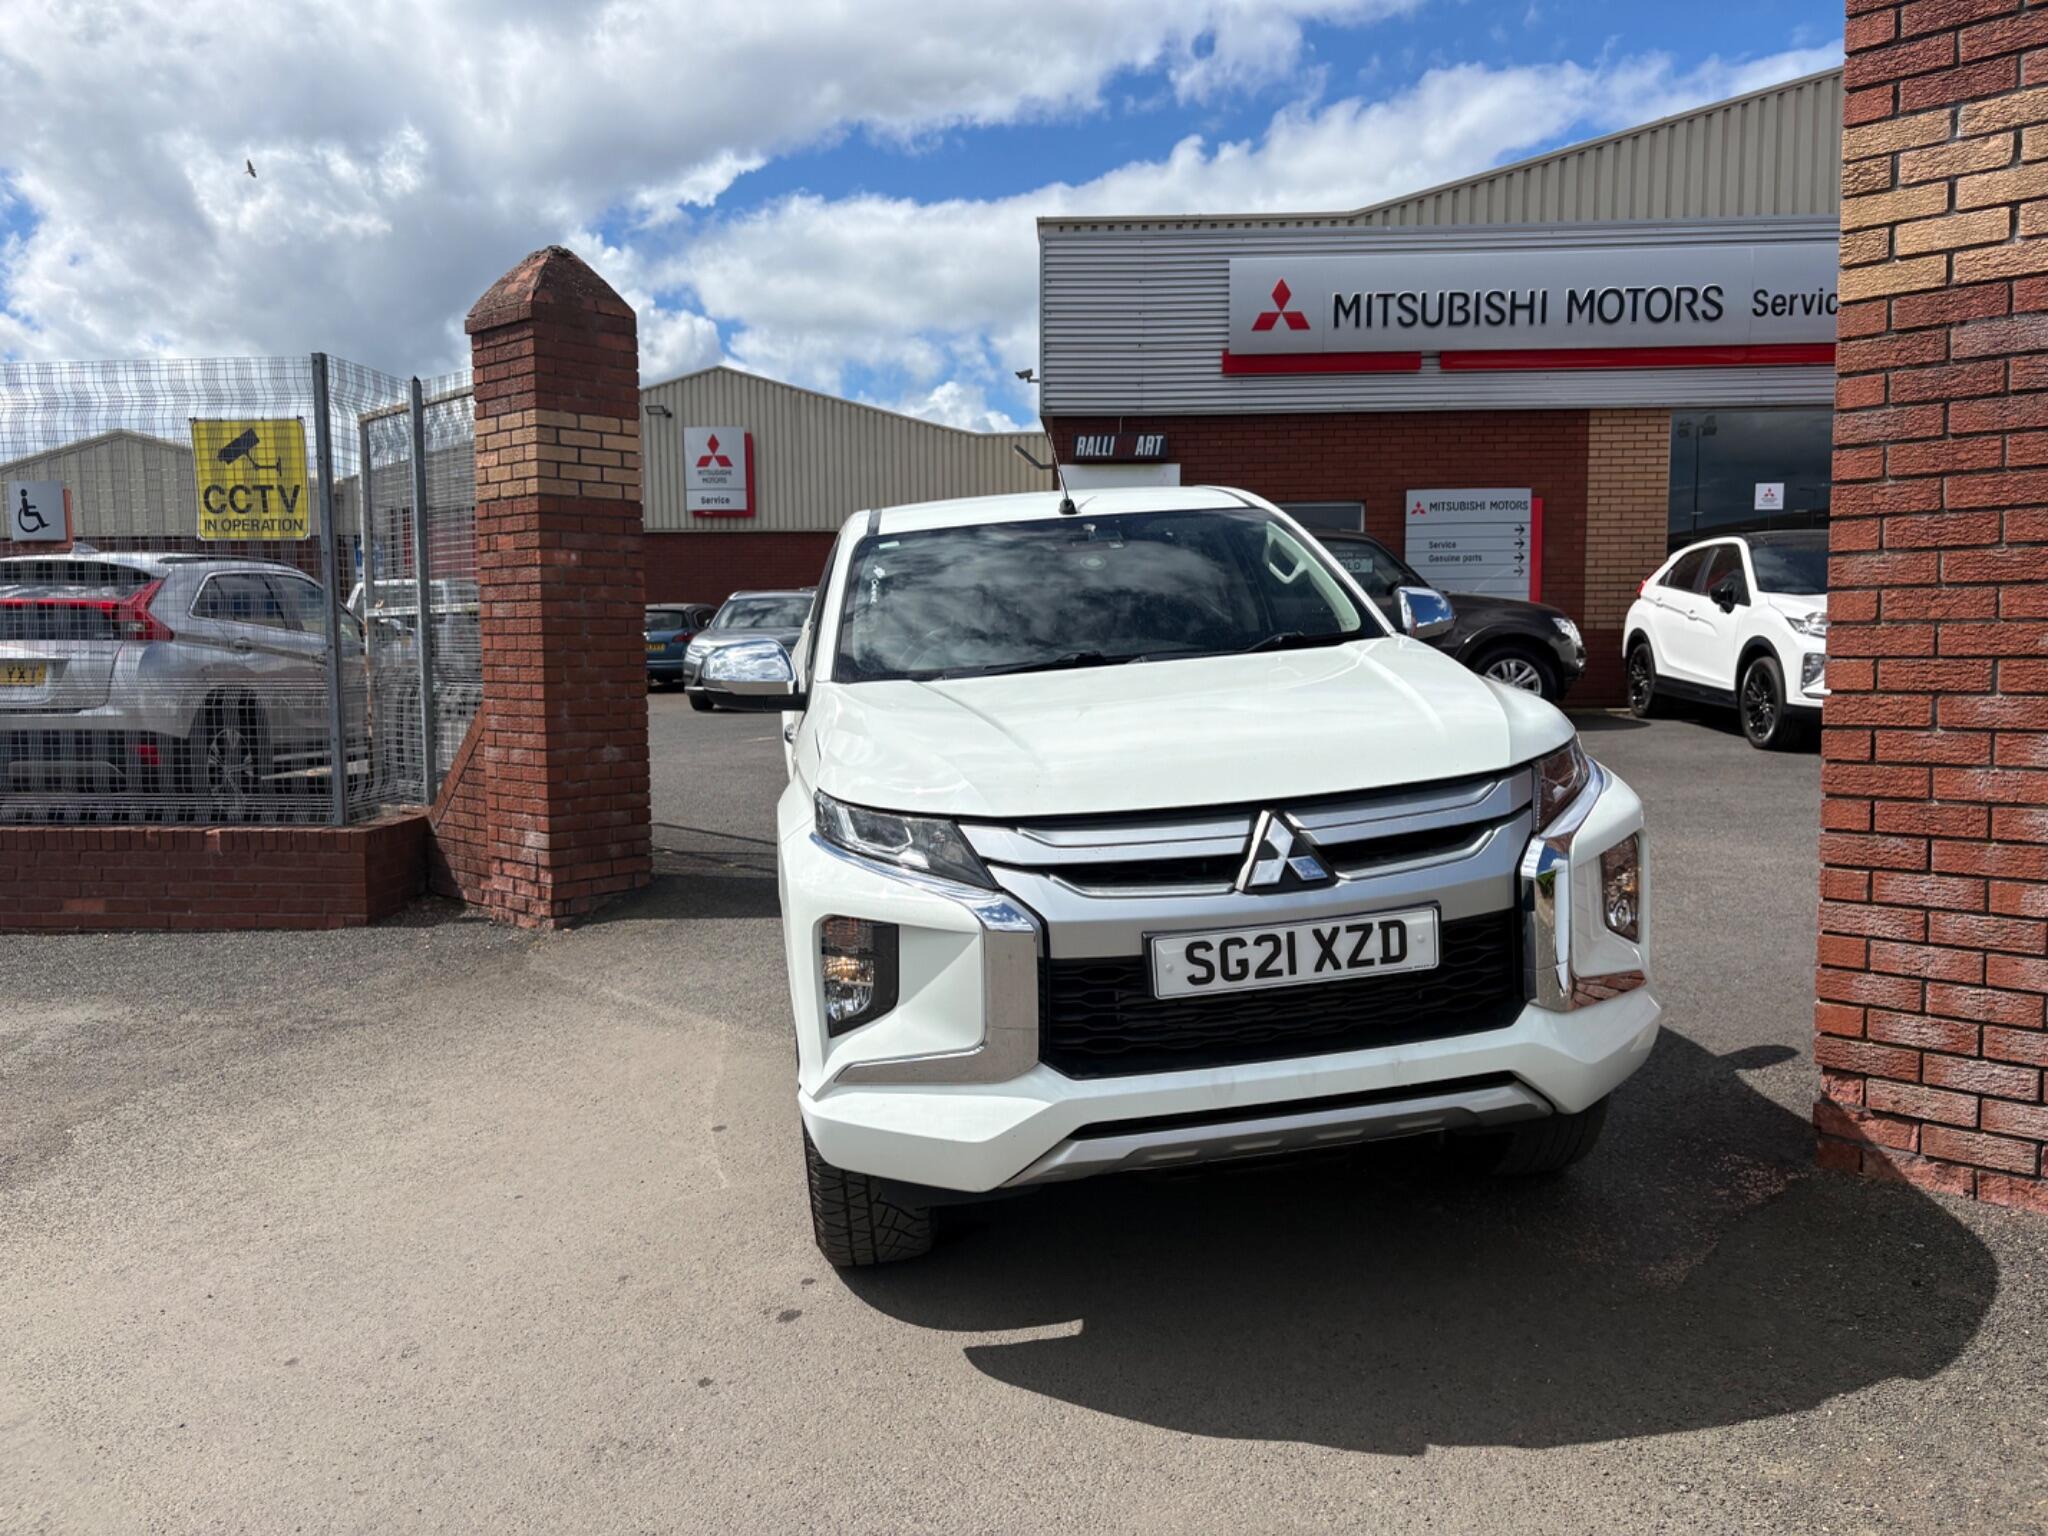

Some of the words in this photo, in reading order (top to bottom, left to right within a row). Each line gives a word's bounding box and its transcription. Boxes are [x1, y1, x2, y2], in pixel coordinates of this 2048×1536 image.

[1332, 289, 1547, 330] MITSUBISHI
[1566, 284, 1724, 325] MOTORS
[1751, 288, 1839, 318] Servic
[1076, 435, 1116, 457] RALLI
[1134, 435, 1164, 456] ART
[203, 484, 300, 514] CCTV
[700, 495, 731, 504] Service
[1429, 501, 1486, 513] MITSUBISHI
[1490, 500, 1528, 511] MOTORS
[204, 519, 217, 532] IN
[220, 519, 303, 532] OPERATION
[1428, 541, 1456, 549] Service
[1428, 554, 1460, 563] Genuine
[1462, 554, 1482, 564] parts
[1184, 931, 1297, 986] SG21
[1312, 919, 1408, 973] XZD
